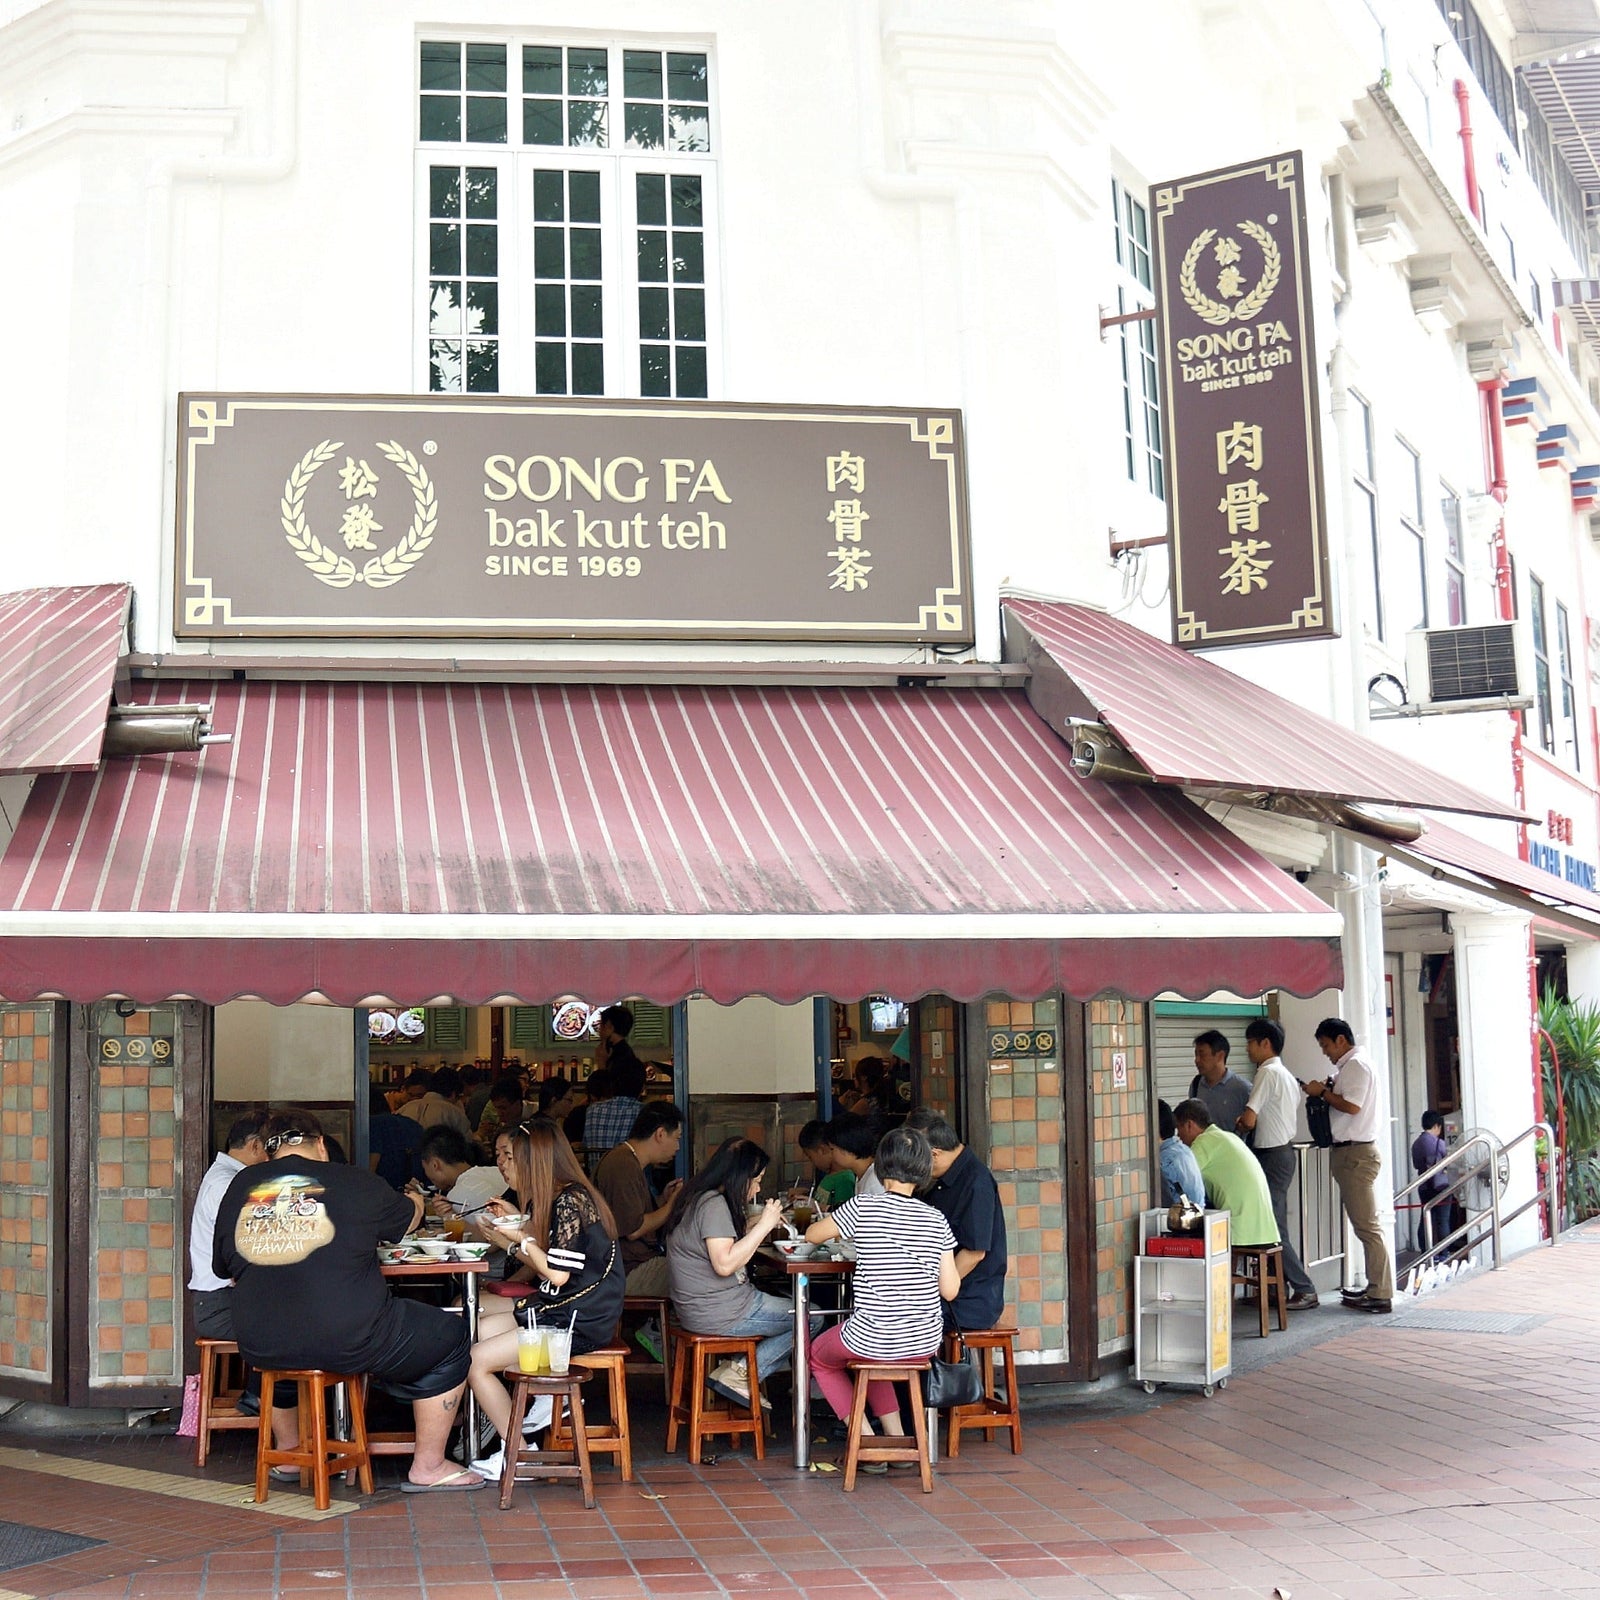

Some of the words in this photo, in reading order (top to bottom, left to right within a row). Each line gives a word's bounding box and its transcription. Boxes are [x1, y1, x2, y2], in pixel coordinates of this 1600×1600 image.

[1177, 327, 1254, 362] SONG
[1256, 320, 1292, 347] FA
[1180, 360, 1219, 383] bak
[1220, 352, 1258, 376] kut
[1258, 345, 1292, 369] teh
[1201, 376, 1240, 393] SINCE
[1242, 369, 1273, 385] 1969
[483, 454, 650, 503] SONG
[659, 458, 733, 504] FA
[338, 456, 383, 551] 松發
[825, 450, 874, 592] 肉骨茶
[1216, 421, 1274, 595] 肉骨茶
[484, 508, 567, 548] bak
[572, 509, 651, 549] kut
[656, 511, 727, 550] teh
[484, 555, 568, 576] SINCE
[577, 555, 642, 577] 1969
[251, 1239, 304, 1255] HAWAII
